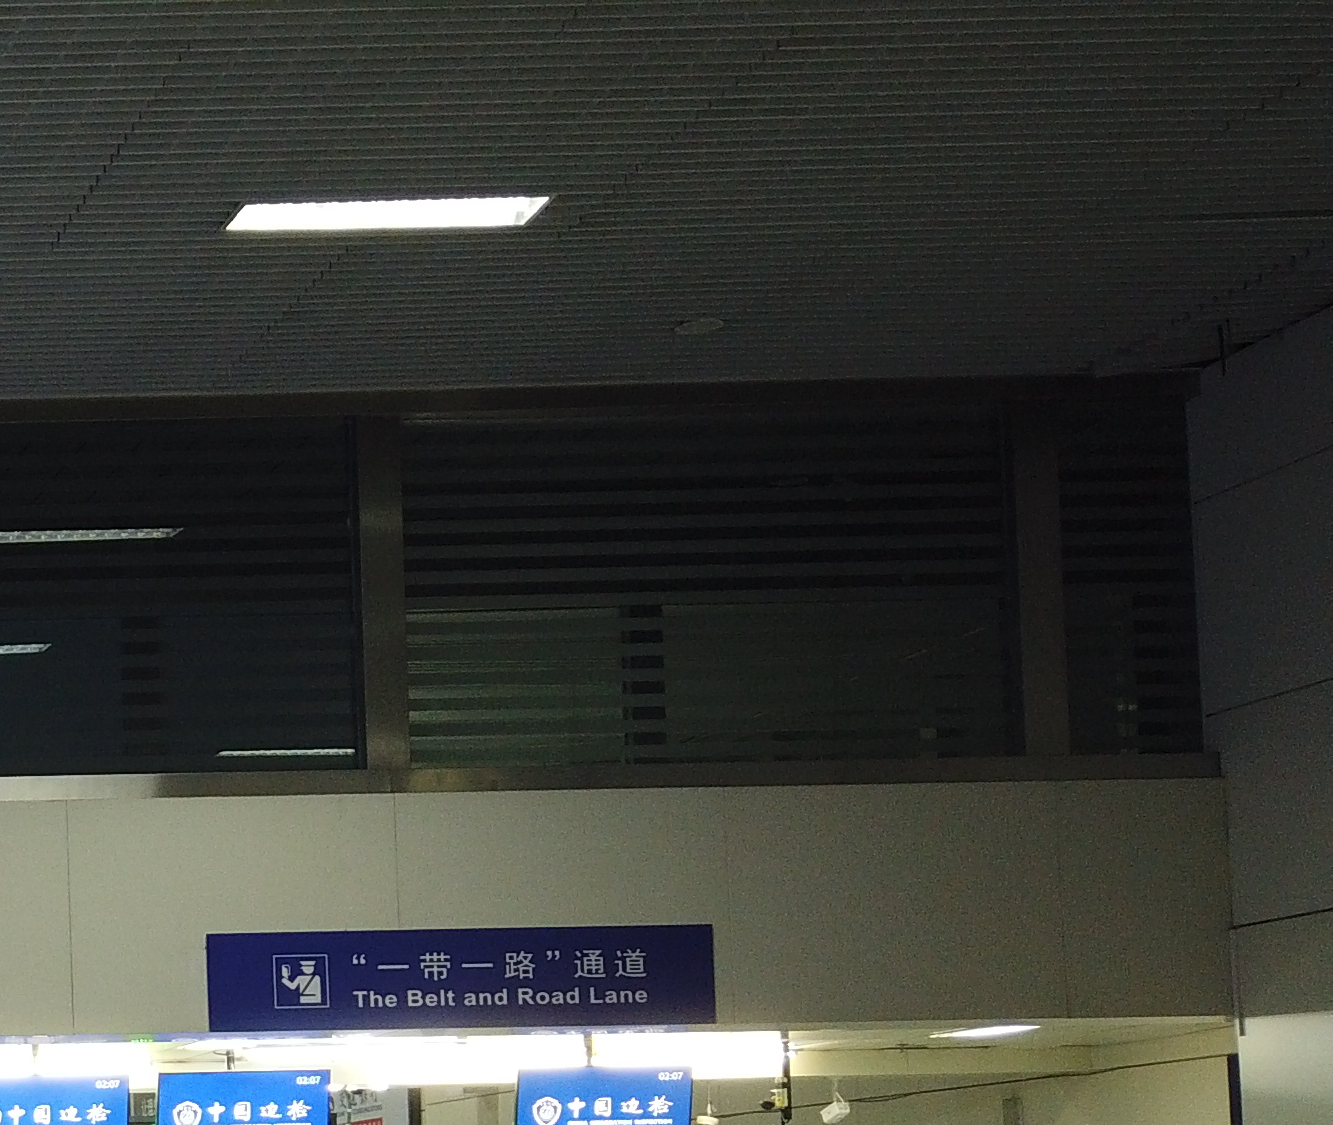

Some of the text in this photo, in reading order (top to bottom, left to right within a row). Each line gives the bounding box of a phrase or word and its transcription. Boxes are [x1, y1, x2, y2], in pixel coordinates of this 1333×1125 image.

[351, 949, 648, 981] “一带一路”通道
[353, 987, 648, 1009] The Belt and Road Lane
[658, 1071, 684, 1081] 02:07
[7, 1102, 112, 1125] 中国边检
[207, 1099, 313, 1123] 中国边检
[567, 1095, 674, 1118] 中国边检
